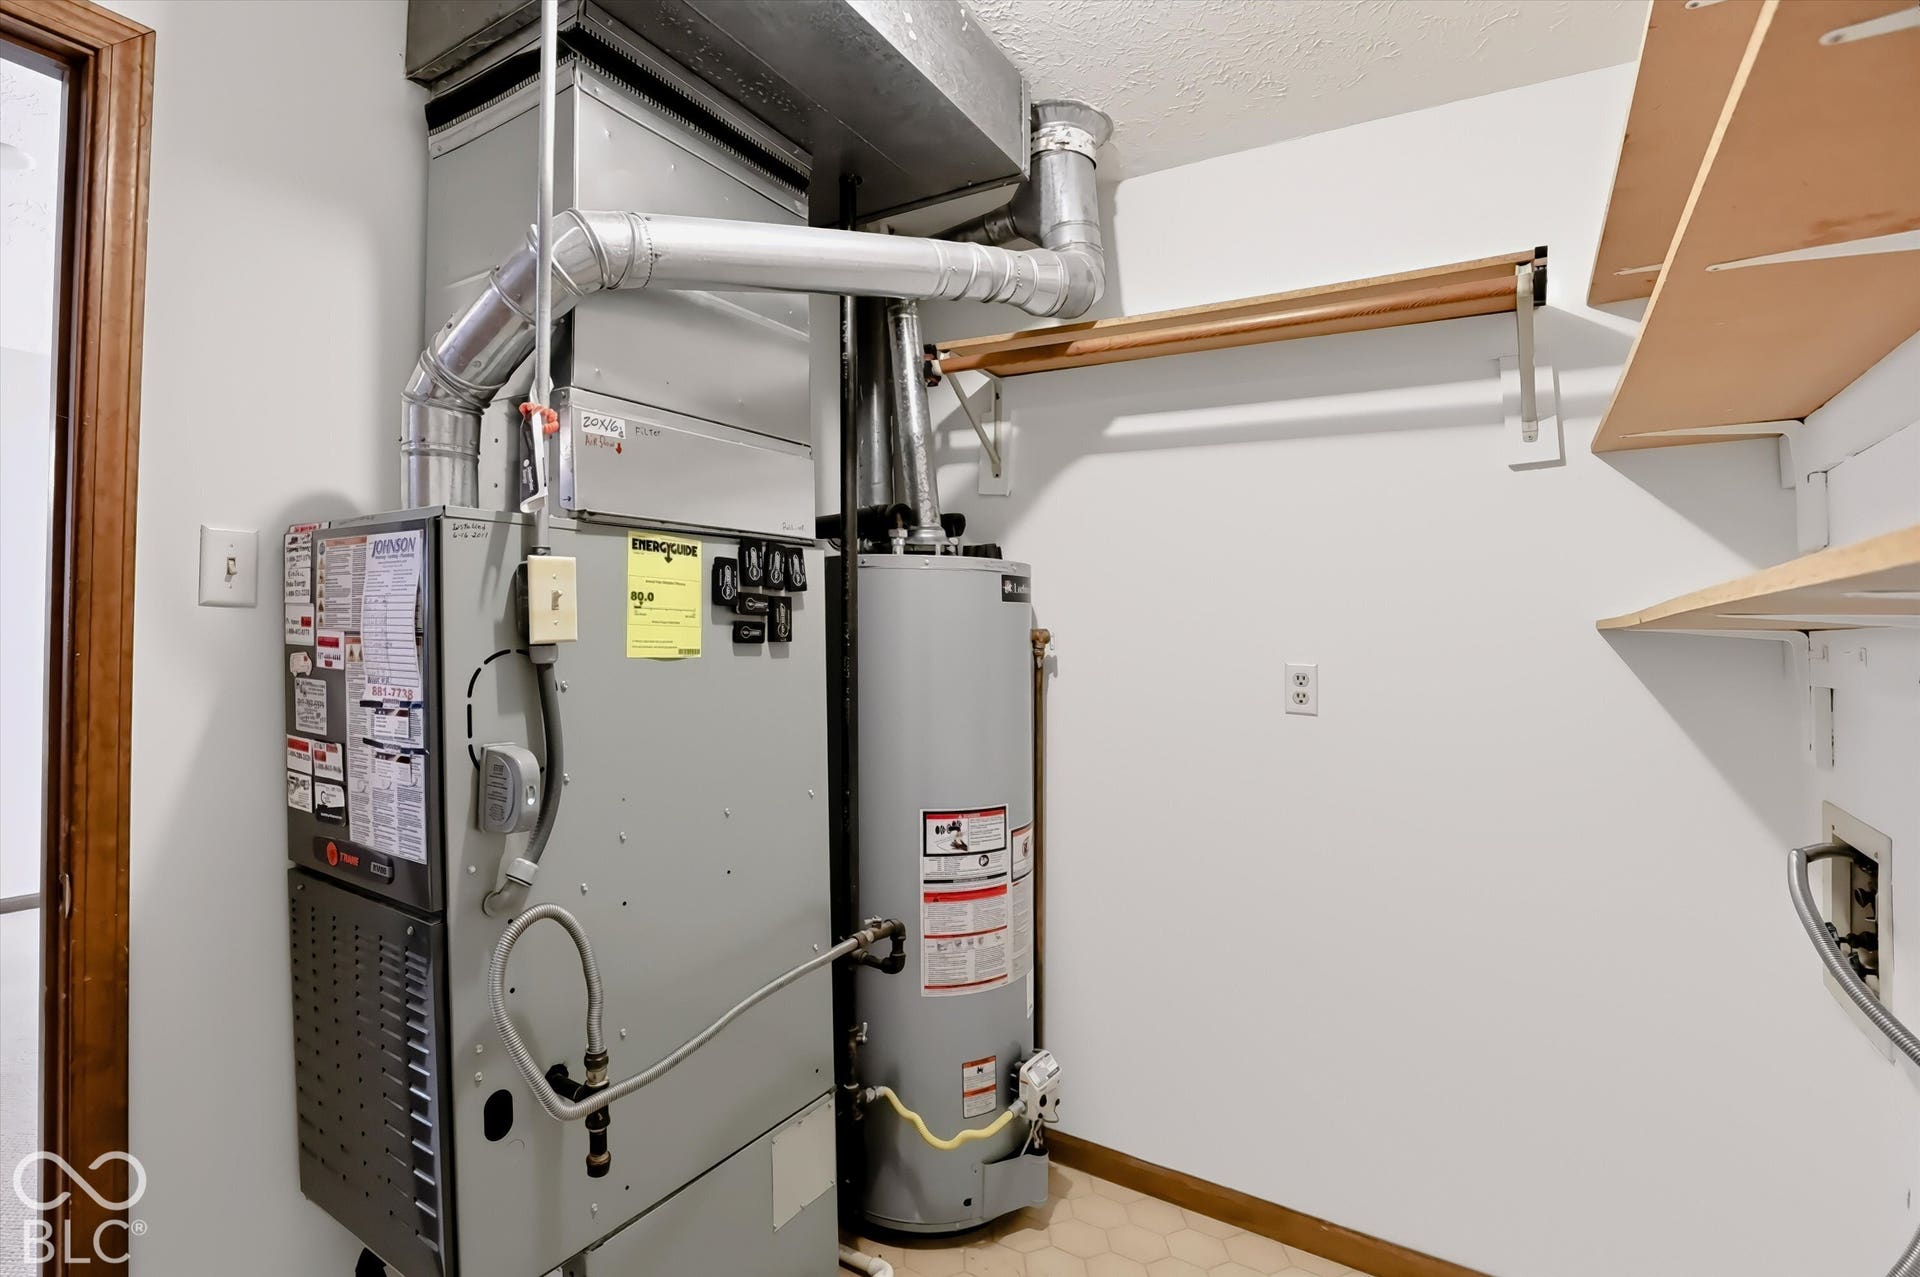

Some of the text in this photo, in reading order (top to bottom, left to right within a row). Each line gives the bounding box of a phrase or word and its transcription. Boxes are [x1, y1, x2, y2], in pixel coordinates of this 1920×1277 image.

[371, 537, 416, 558] JOHNSON
[631, 537, 698, 558] ENERGYGUIDE
[630, 591, 654, 602] 80.0
